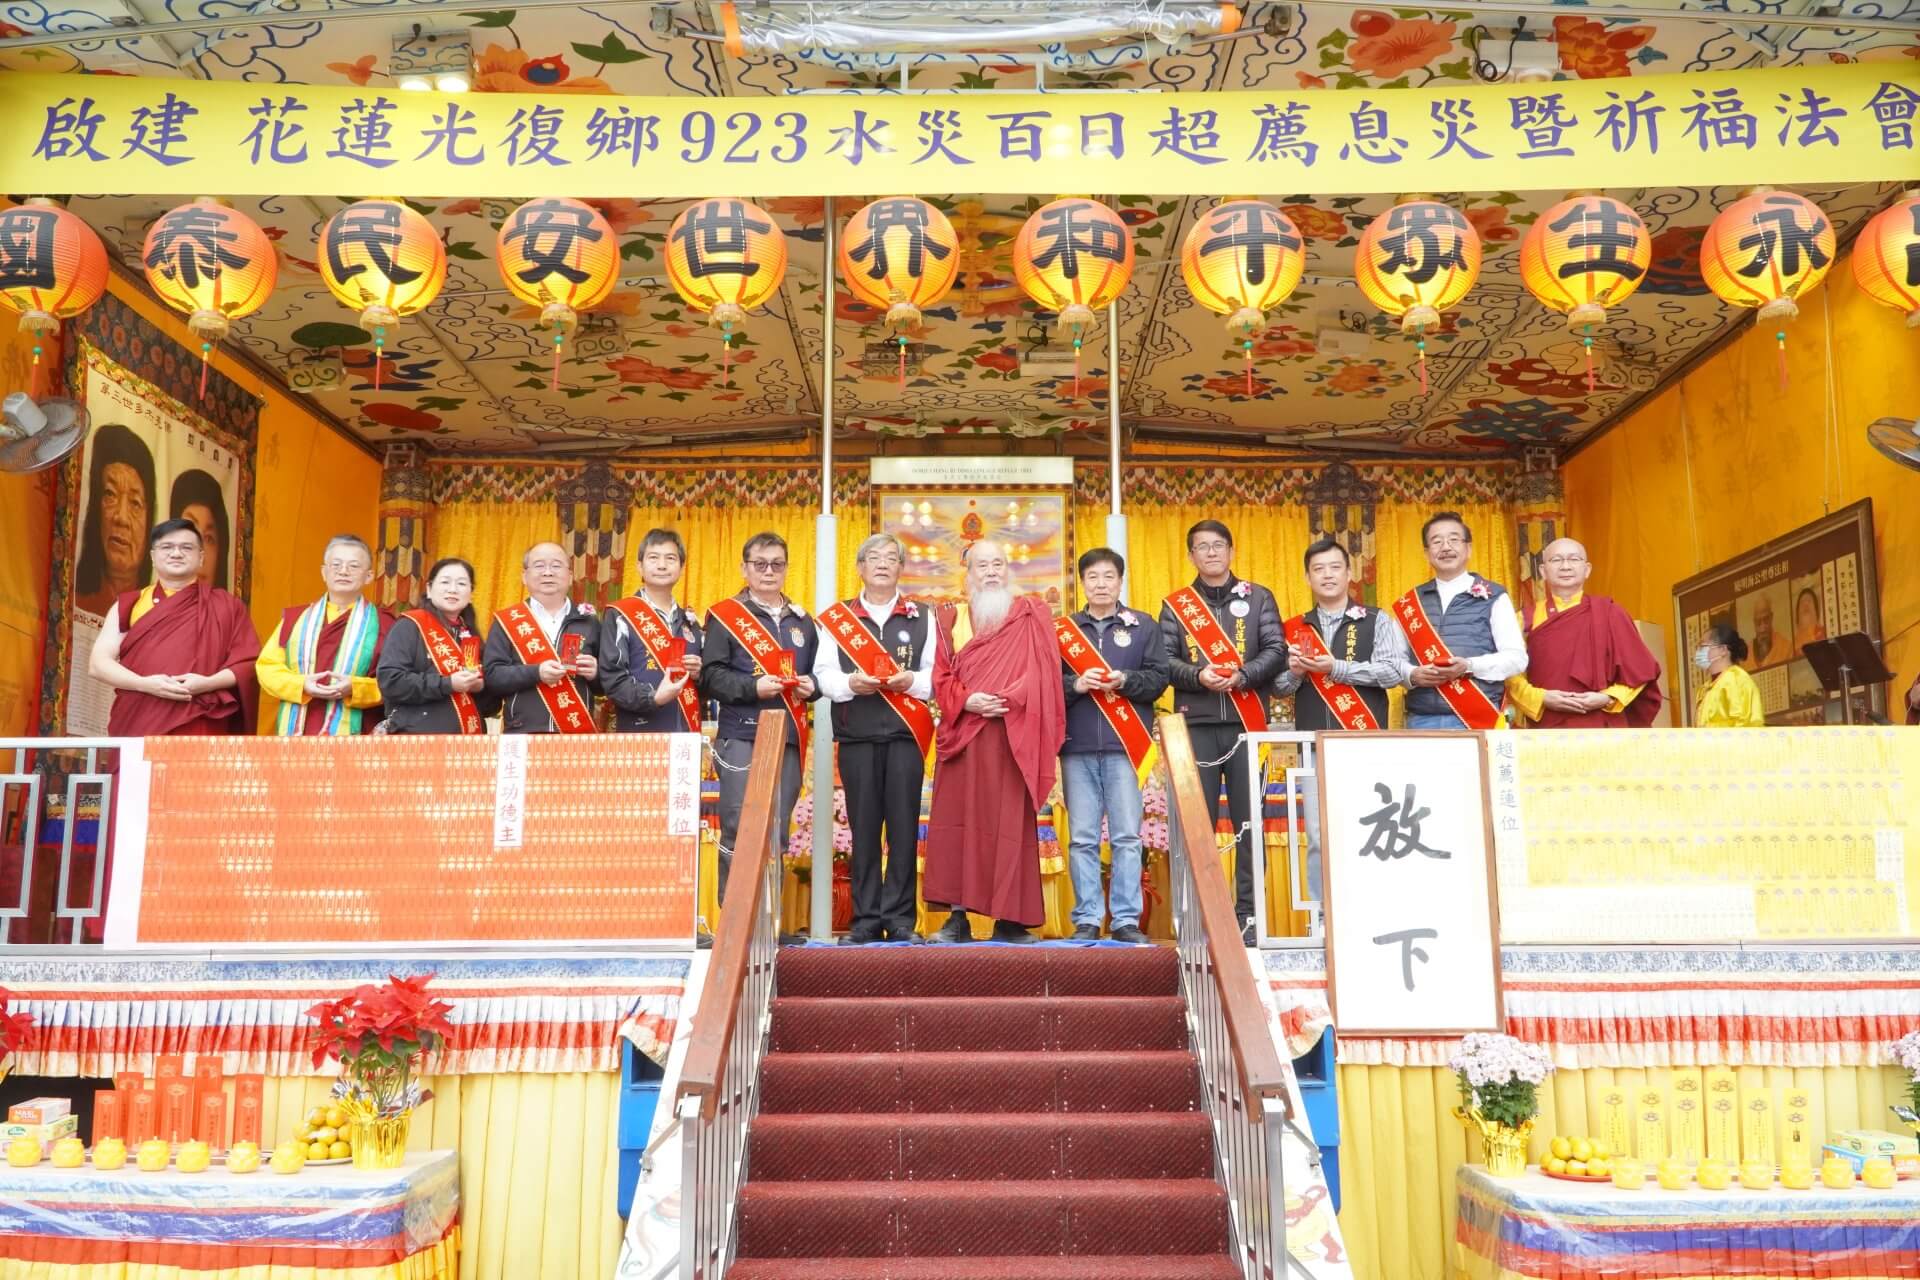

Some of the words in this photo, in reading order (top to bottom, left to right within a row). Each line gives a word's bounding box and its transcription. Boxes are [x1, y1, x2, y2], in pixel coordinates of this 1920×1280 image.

[32, 92, 199, 166] 啟建
[240, 82, 1920, 169] 花蓮光復鄉923水災百日超薦息災暨祈福法會
[145, 209, 250, 289] 泰
[328, 203, 424, 285] 民
[502, 199, 602, 284] 安
[666, 201, 771, 278] 世
[851, 202, 948, 280] 界
[1031, 204, 1128, 279] 和
[1200, 204, 1301, 285] 平
[1547, 200, 1644, 281] 生
[1739, 196, 1828, 279] 永
[1358, 782, 1452, 992] 放下
